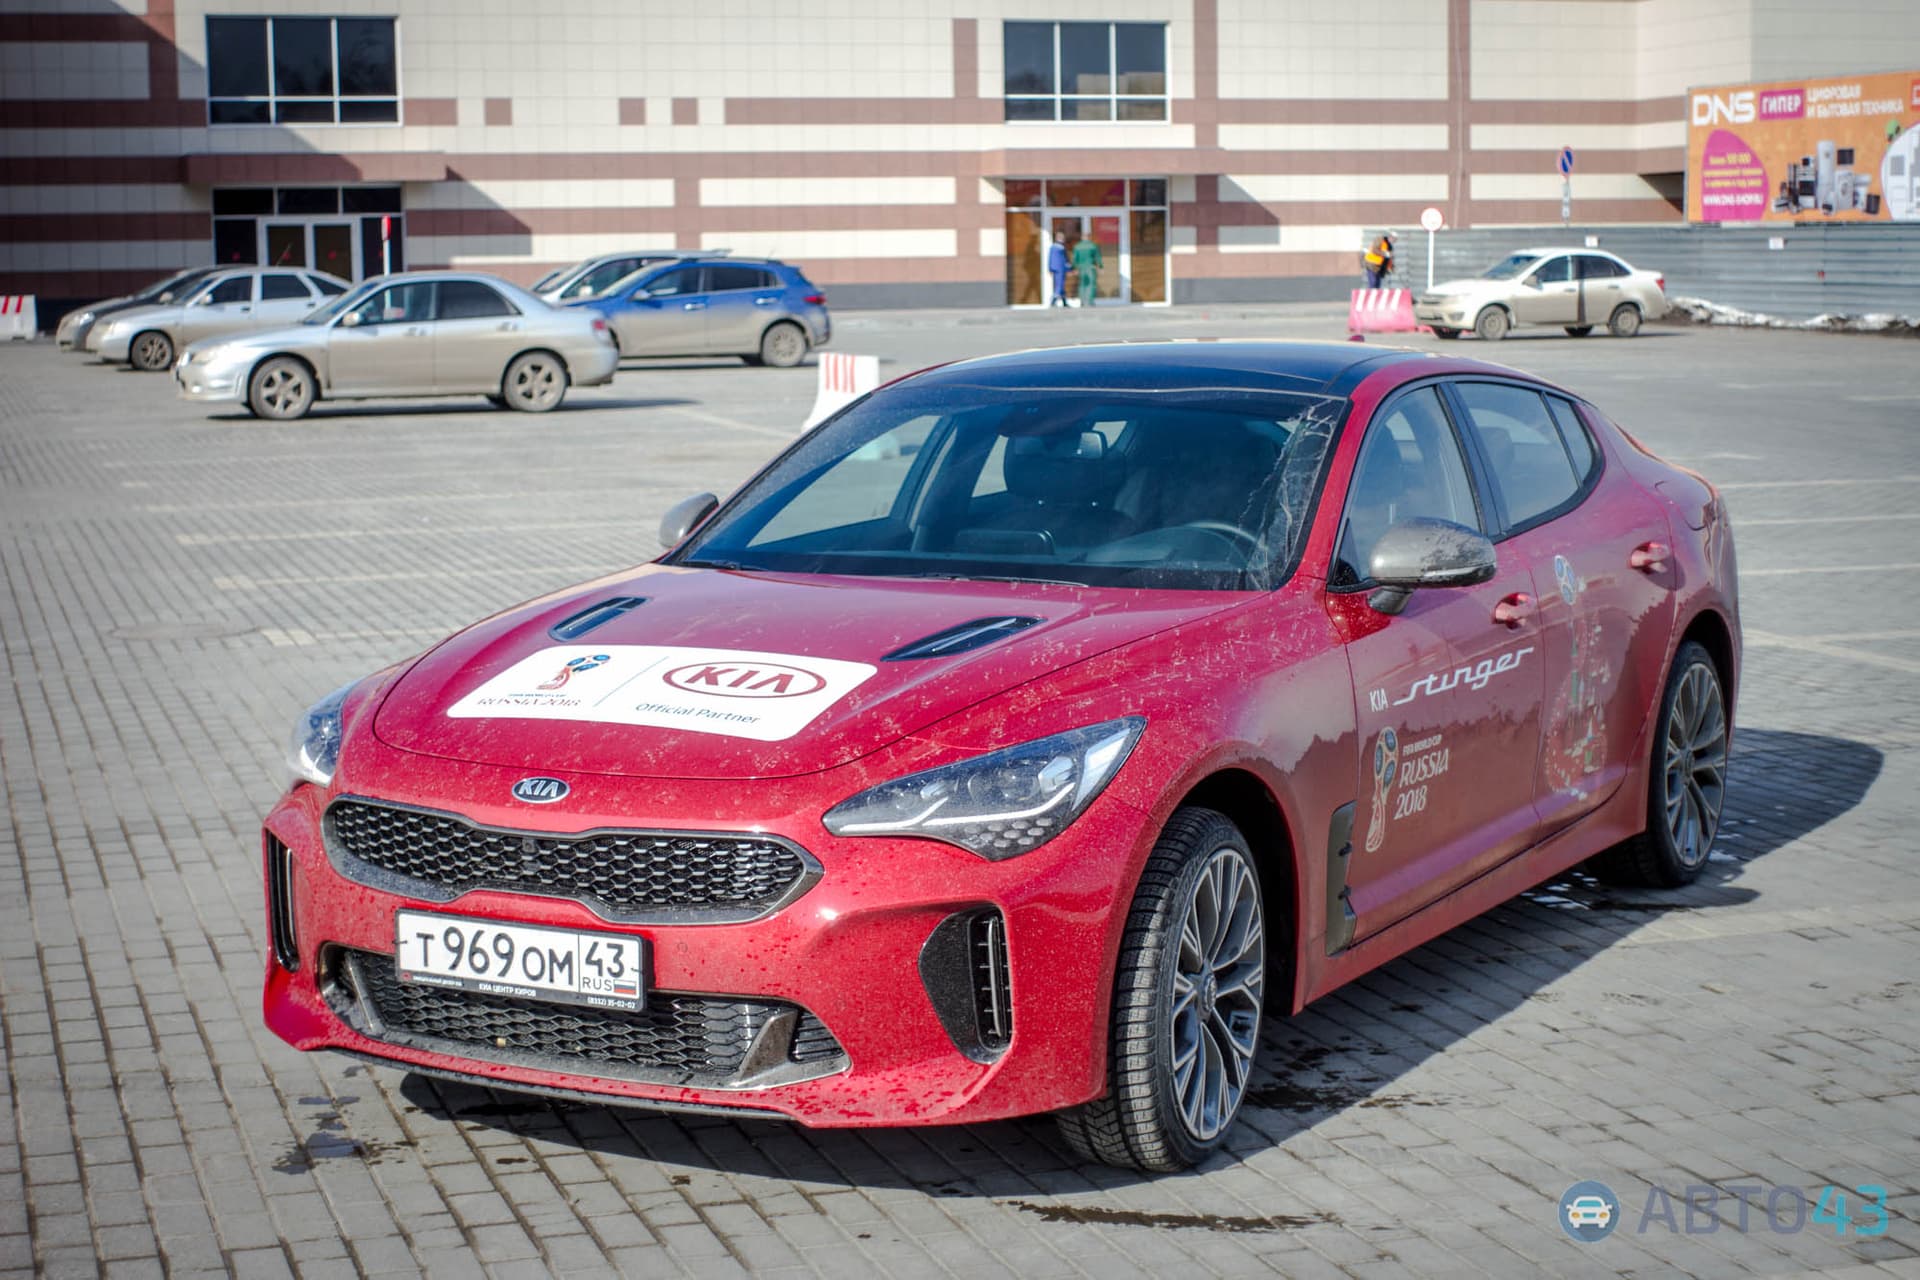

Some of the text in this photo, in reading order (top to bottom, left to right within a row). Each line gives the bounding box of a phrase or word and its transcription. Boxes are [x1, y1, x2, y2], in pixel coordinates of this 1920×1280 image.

[1761, 94, 1802, 115] ГИПЕР
[1806, 84, 1861, 102] ЦИФРОВАЯ
[1692, 91, 1756, 126] DNS
[1806, 98, 1904, 118] И БЫТОВАЯ ТЕХНИКА
[689, 665, 795, 695] KIA
[1369, 647, 1535, 712] KIA stinger
[635, 702, 761, 726] Official Partner
[1399, 748, 1450, 789] RUSSIA
[518, 781, 559, 797] KIA
[1394, 785, 1428, 821] 2018
[585, 941, 625, 979] 43
[582, 976, 613, 992] RUS
